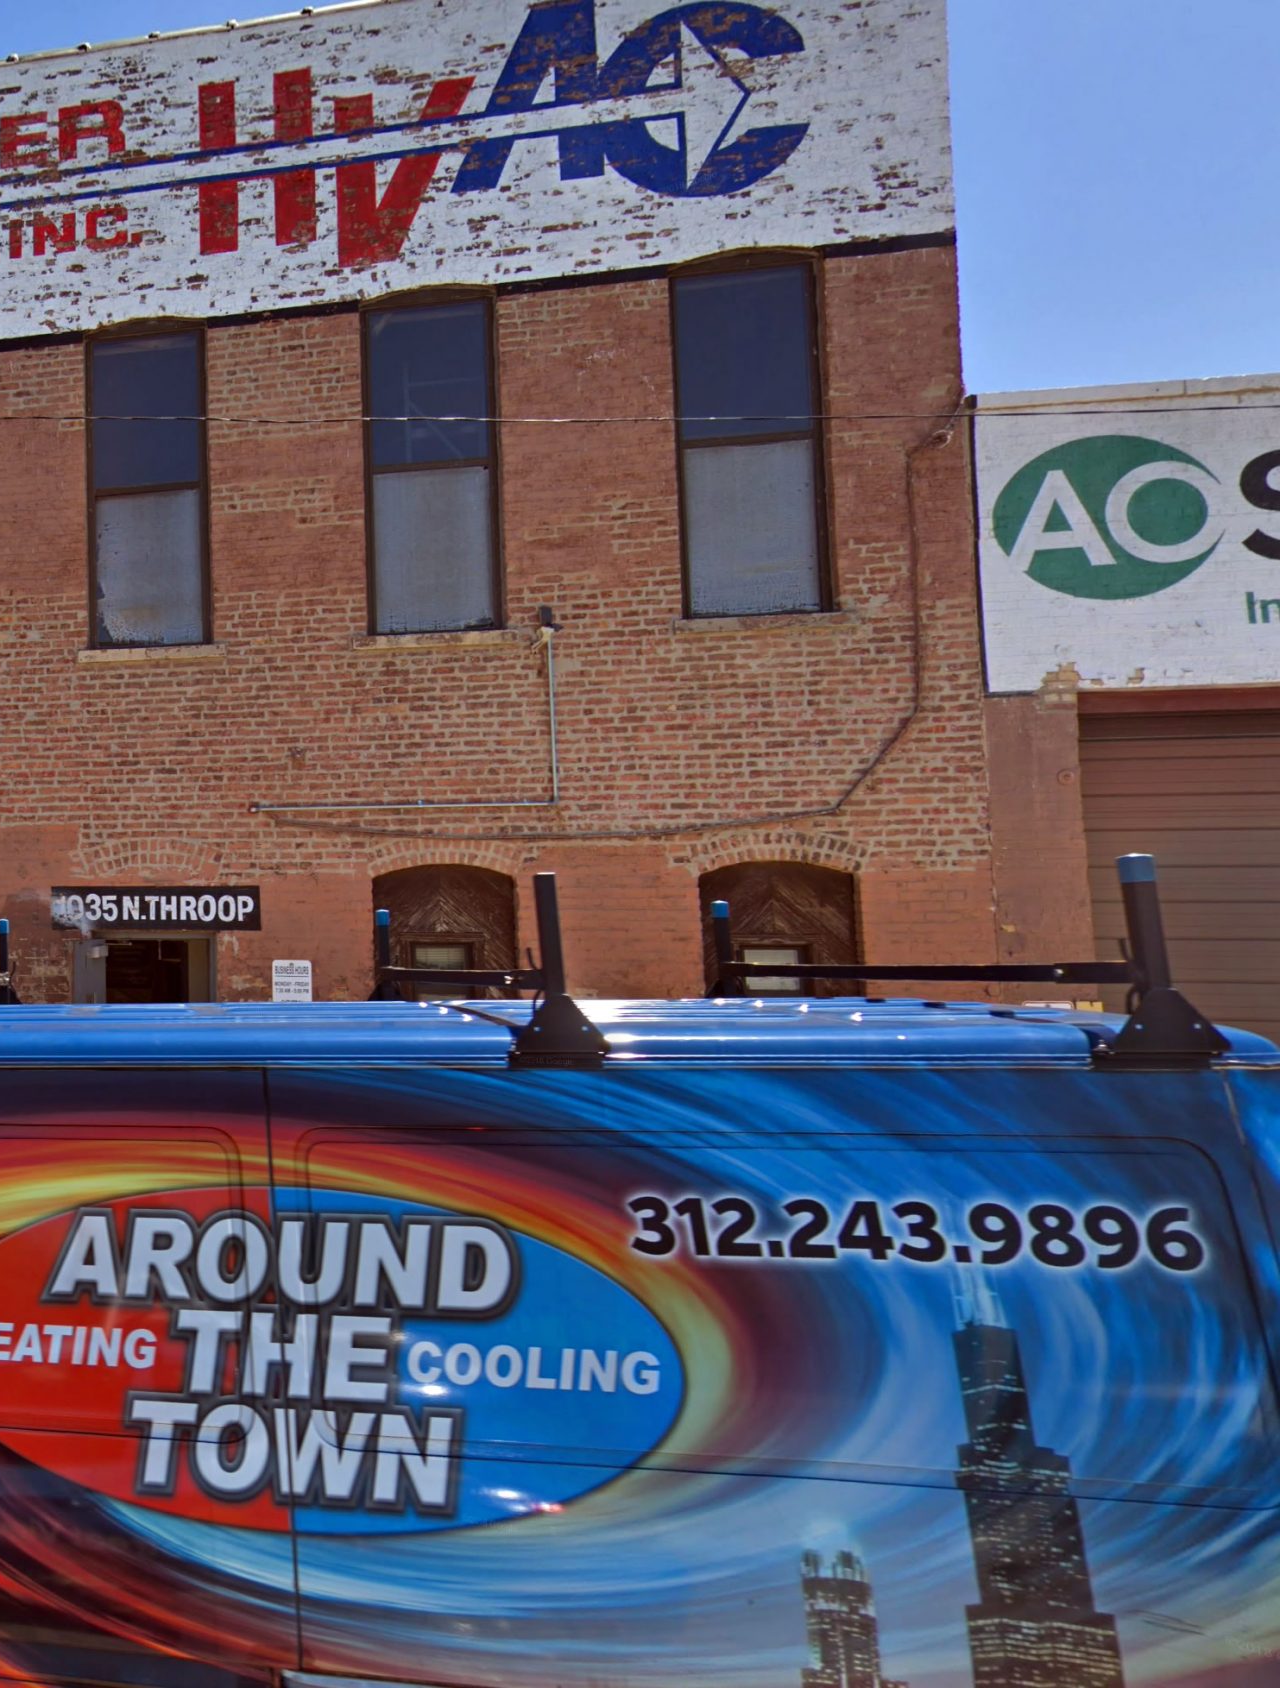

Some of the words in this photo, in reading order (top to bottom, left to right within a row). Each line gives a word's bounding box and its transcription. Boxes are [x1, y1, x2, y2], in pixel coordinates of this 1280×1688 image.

[198, 0, 811, 268] HVAC
[48, 1213, 514, 1313] AROUND
[628, 1196, 1205, 1272] 312.243.9896
[175, 1308, 390, 1402] THE
[407, 1341, 661, 1395] COOLING
[130, 1401, 453, 1505] TOWN
